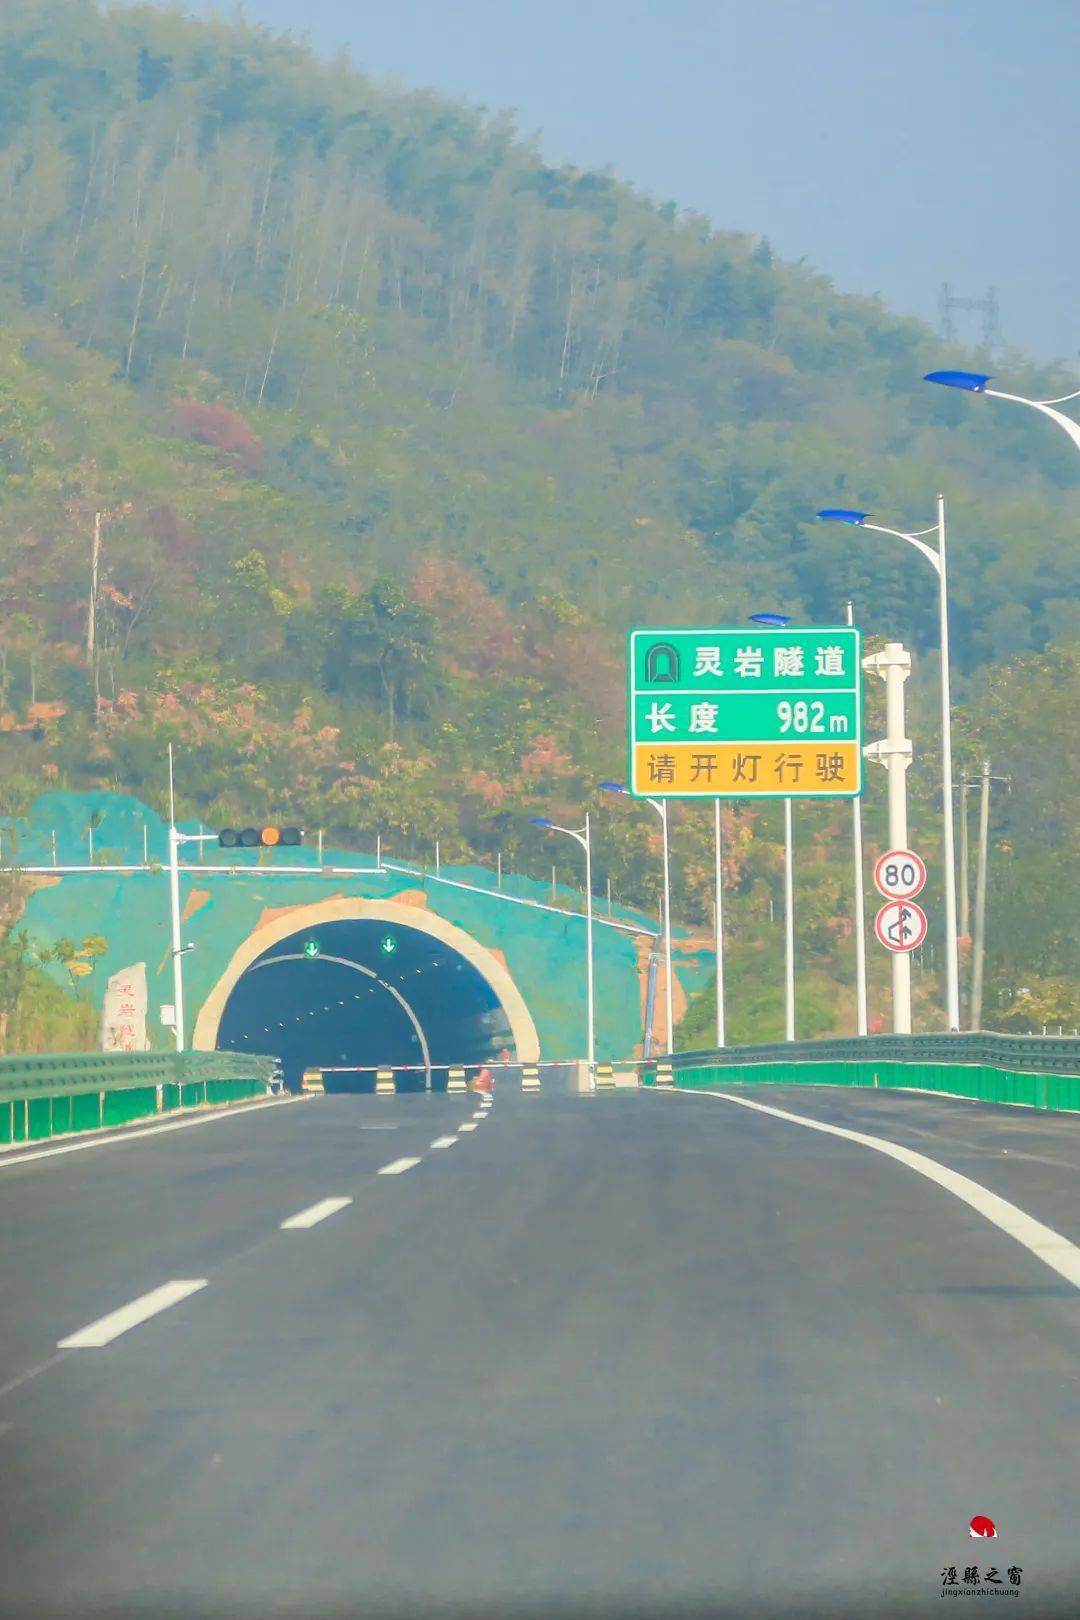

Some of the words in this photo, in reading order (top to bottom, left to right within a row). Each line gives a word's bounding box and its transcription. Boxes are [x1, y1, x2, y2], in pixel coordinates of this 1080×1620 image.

[693, 646, 846, 678] 灵岩隧道
[645, 702, 719, 733] 长度
[647, 753, 846, 783] 请开灯行驶
[886, 864, 915, 886] 80
